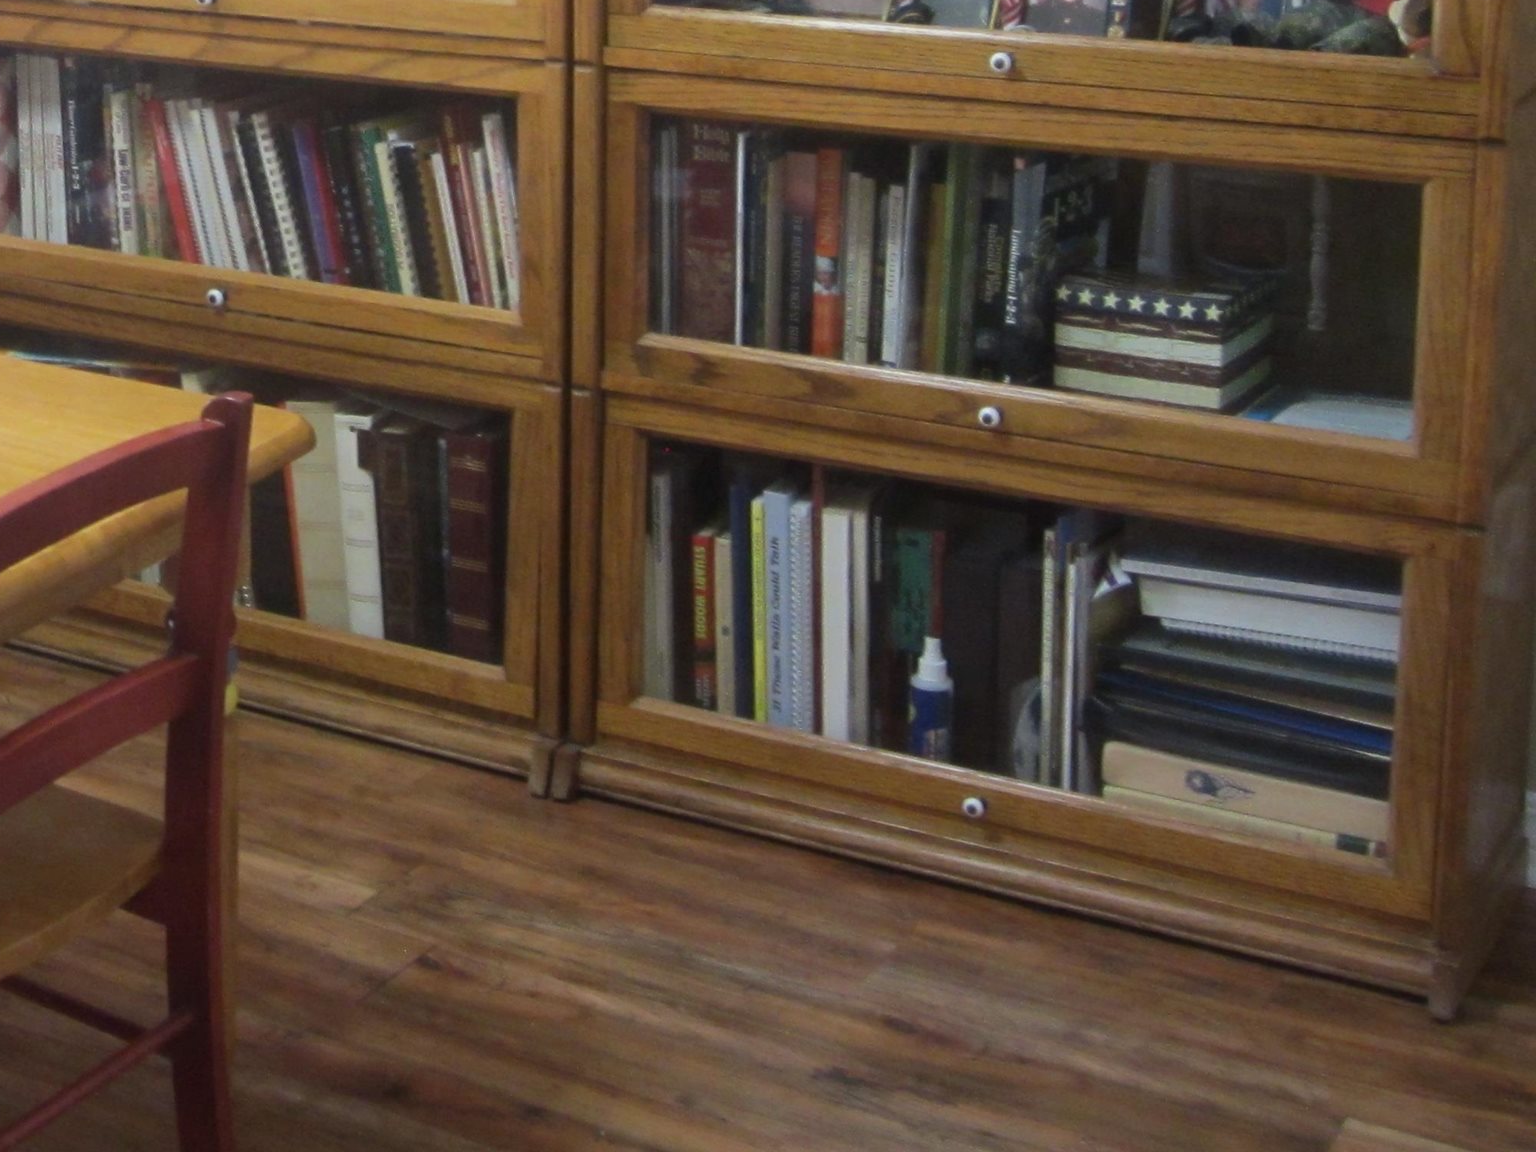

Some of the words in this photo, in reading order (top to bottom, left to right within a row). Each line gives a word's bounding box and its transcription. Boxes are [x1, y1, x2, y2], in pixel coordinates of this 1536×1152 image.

[1007, 229, 1022, 294] Landscaping
[1005, 295, 1018, 325] 1-2-3
[695, 546, 707, 590] STUART
[695, 595, 707, 640] WOODS
